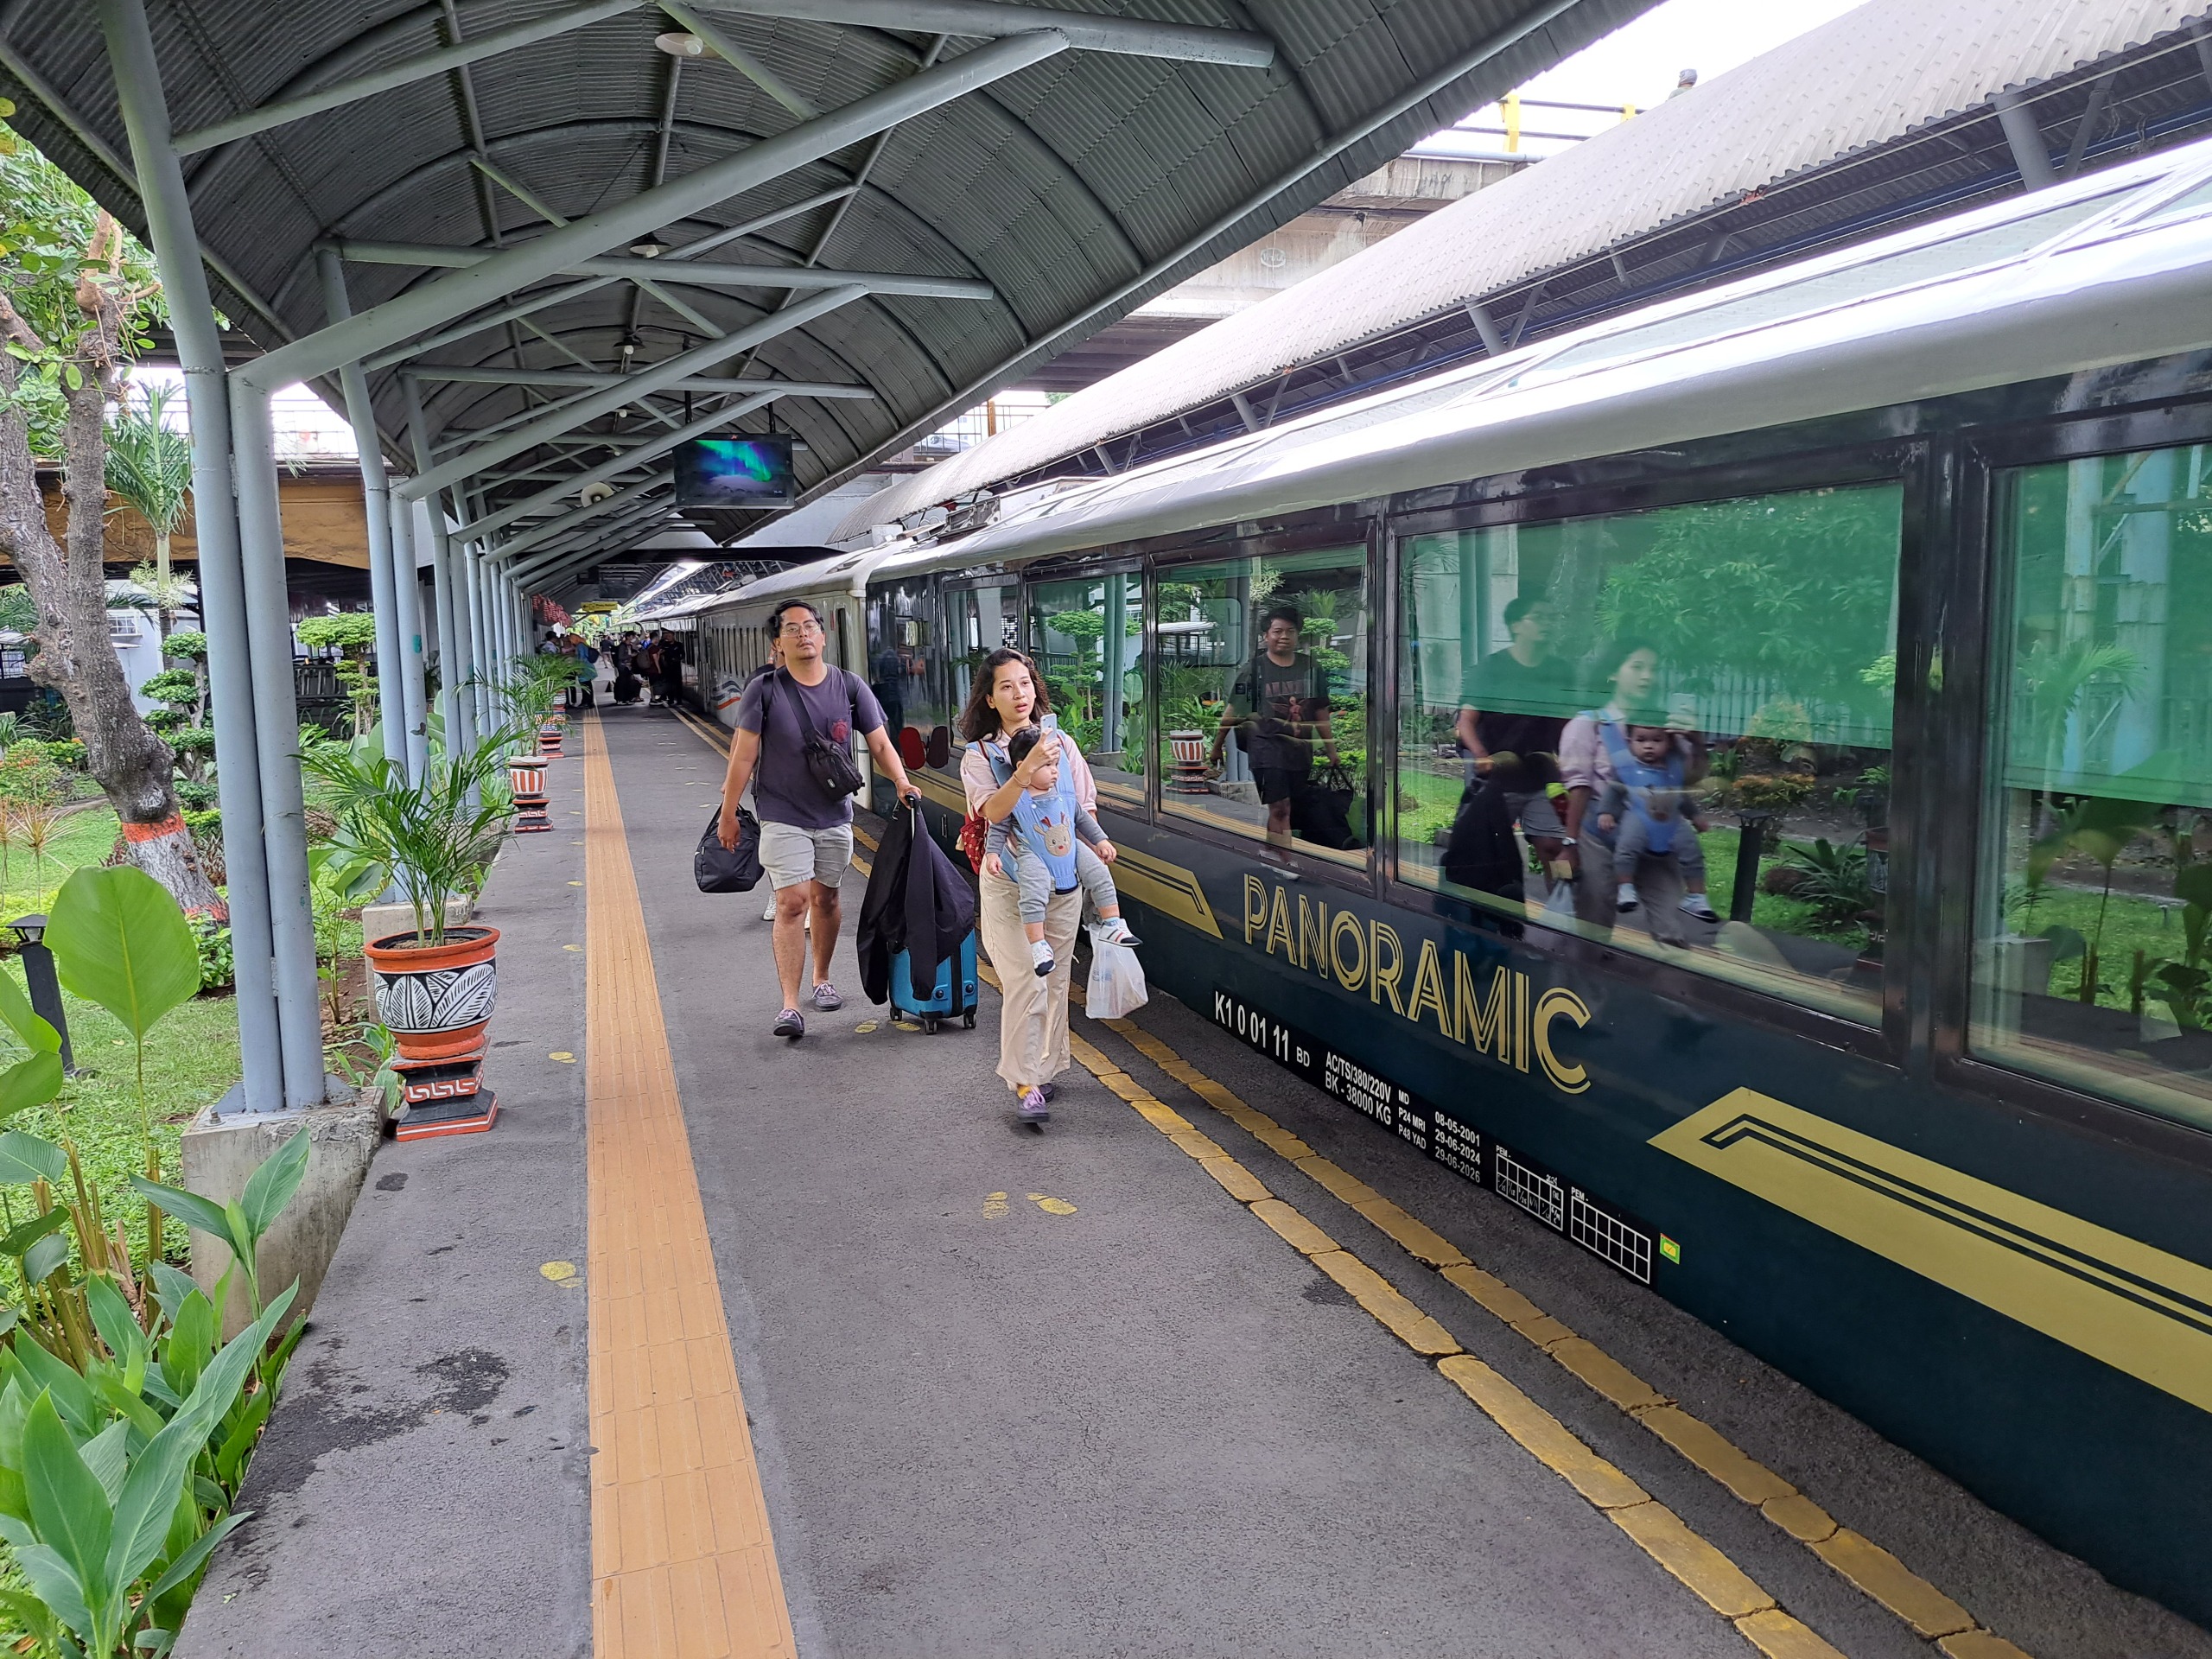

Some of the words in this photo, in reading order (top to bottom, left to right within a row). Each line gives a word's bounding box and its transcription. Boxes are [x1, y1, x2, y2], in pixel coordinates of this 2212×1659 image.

[1244, 874, 1592, 1094] PANORAMIC
[1215, 990, 1231, 1028] K1
[1237, 1004, 1245, 1035] 0
[1250, 1012, 1266, 1048] 01
[1273, 1025, 1288, 1062] 11
[1296, 1046, 1310, 1067] BD
[1325, 1052, 1391, 1103] AC/TS/380/220V
[1325, 1071, 1338, 1094] BK
[1346, 1084, 1373, 1115] 38000
[1376, 1100, 1392, 1125] KG
[1398, 1090, 1409, 1105] MD
[1398, 1107, 1411, 1123] P24
[1412, 1115, 1426, 1133] MRI
[1435, 1111, 1480, 1147] 08-05-2001
[1412, 1132, 1427, 1149] YAD
[1435, 1128, 1481, 1165] 29-06-2024
[1435, 1146, 1481, 1183] 29-06-2026
